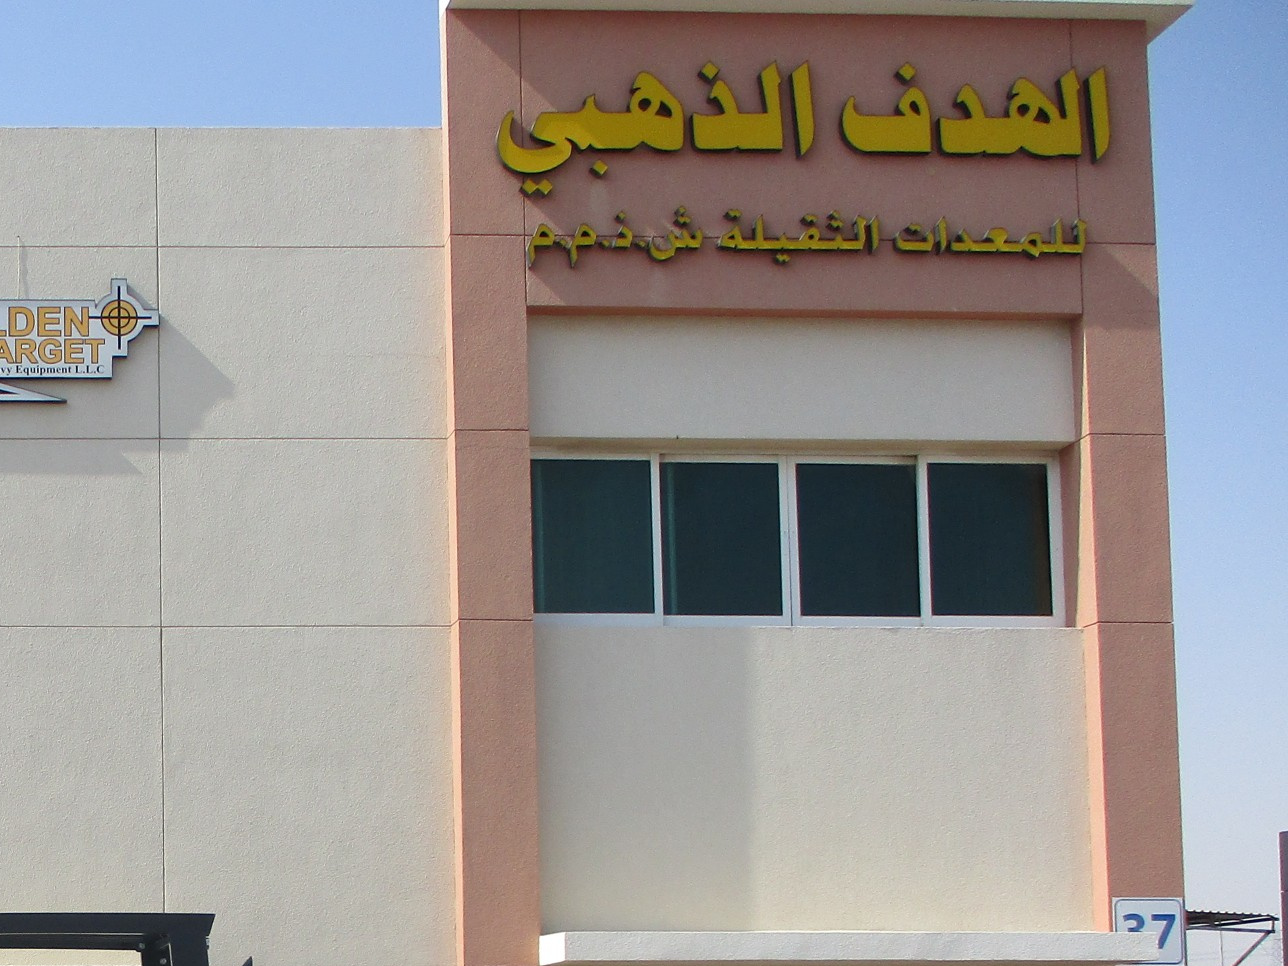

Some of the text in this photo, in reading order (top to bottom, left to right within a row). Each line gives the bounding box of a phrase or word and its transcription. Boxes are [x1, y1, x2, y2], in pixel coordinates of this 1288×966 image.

[496, 60, 1111, 196] الهدف الذهبي
[716, 208, 880, 267] الثقيلة
[891, 216, 1087, 259] للمعدات
[14, 364, 73, 377] Equipment
